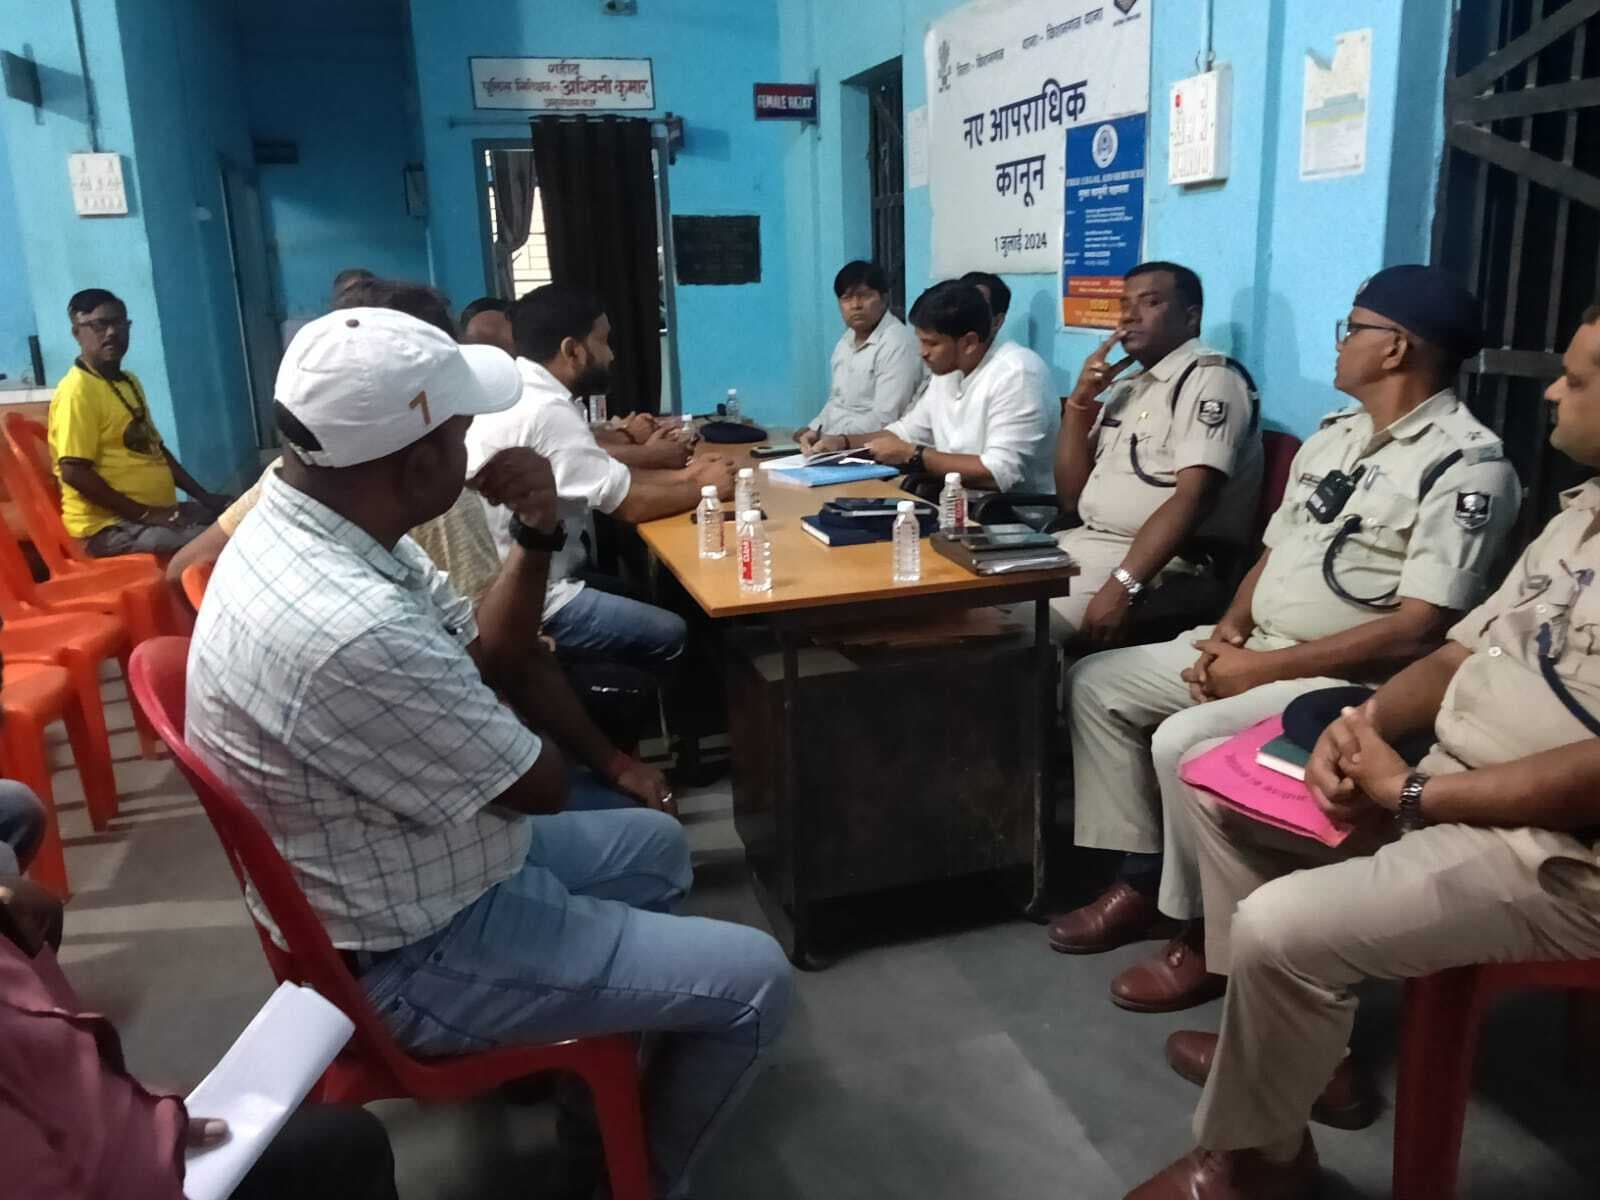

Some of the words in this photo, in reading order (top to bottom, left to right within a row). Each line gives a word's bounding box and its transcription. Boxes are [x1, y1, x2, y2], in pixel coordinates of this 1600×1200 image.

[963, 113, 985, 150] नए
[990, 78, 1088, 143] आपराधिक
[995, 154, 1046, 207] कानून
[1000, 228, 1023, 257] जुलाई
[1024, 232, 1047, 250] 2024
